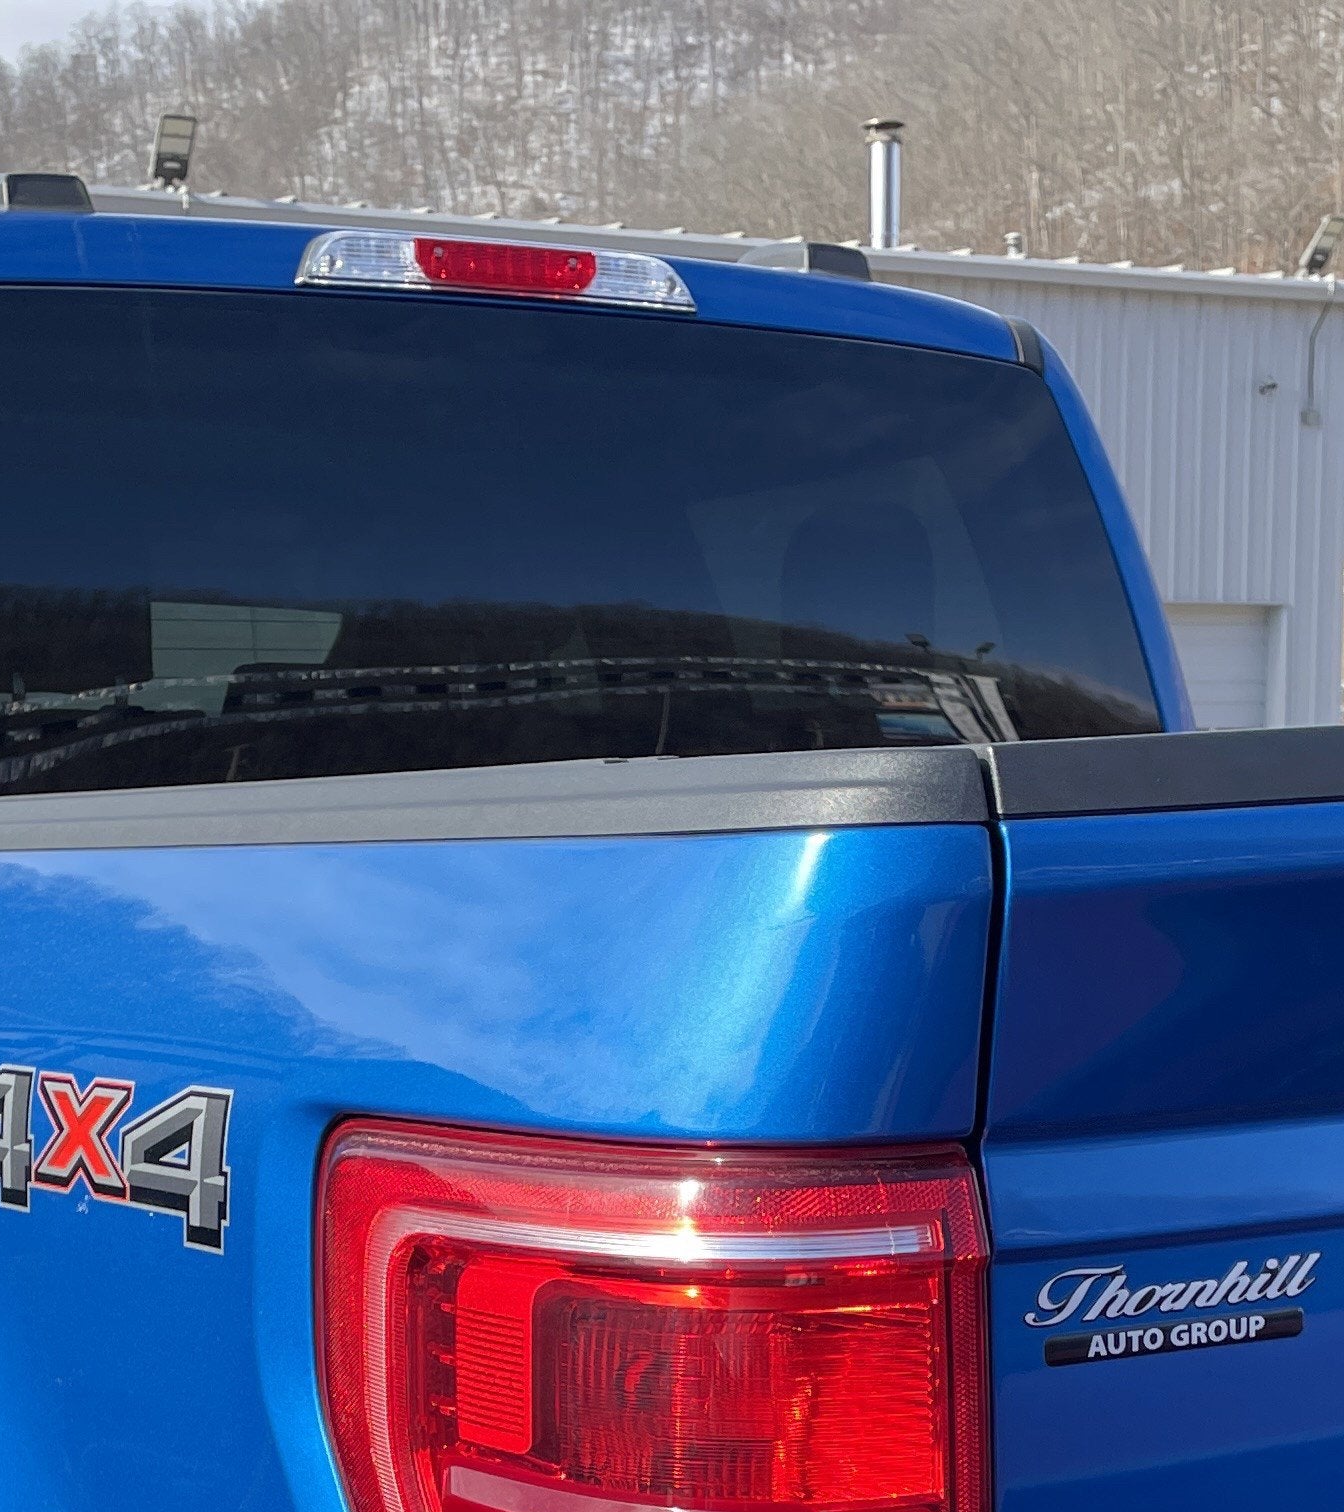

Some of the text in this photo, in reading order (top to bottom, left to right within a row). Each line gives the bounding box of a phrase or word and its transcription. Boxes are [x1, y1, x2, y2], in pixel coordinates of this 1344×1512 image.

[1023, 1252, 1322, 1328] Thornhill
[1087, 1315, 1267, 1359] AUTO GROUP
